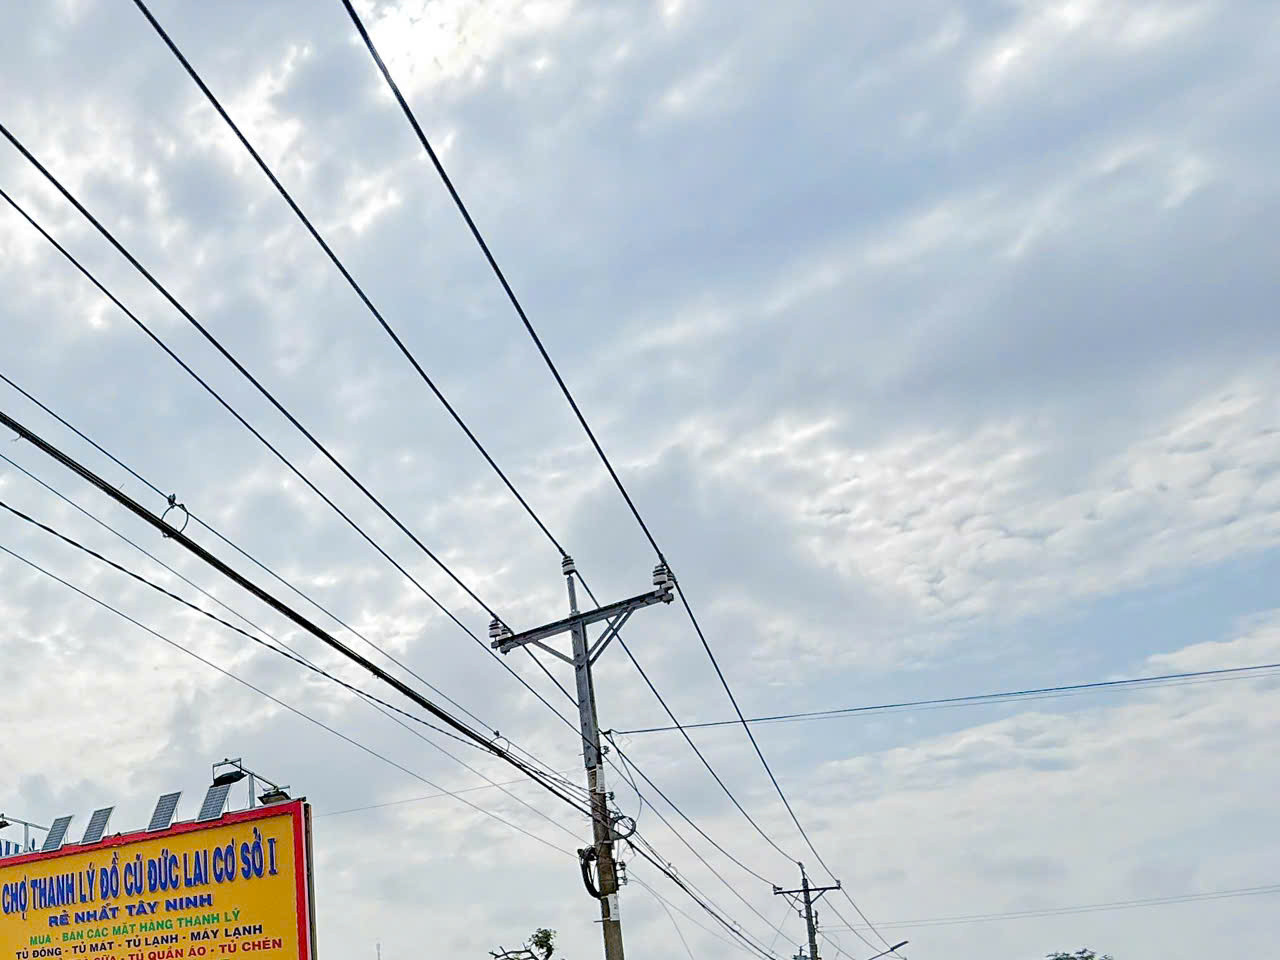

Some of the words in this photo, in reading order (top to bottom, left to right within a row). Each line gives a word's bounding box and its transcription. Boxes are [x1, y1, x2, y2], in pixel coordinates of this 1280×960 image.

[2, 874, 29, 920] CHỢ
[31, 873, 76, 910] THANH
[80, 862, 96, 903] LÝ
[100, 852, 120, 900] ĐỒ
[124, 853, 144, 896] CŨ
[147, 849, 179, 892] ĐỨC
[183, 849, 209, 887] LAI
[213, 838, 237, 883] CƠ
[241, 827, 264, 879] SỞ
[30, 936, 51, 946] MUA
[62, 930, 84, 942] BÁN
[87, 926, 109, 938] CÁC
[140, 919, 173, 932] HÀNG
[177, 913, 219, 928] THANH
[224, 908, 240, 922] LÝ
[48, 910, 70, 927] RẺ
[74, 903, 120, 923] NHẤT
[126, 900, 159, 917] TÂY
[165, 894, 213, 911] NINH
[16, 948, 29, 960] TỦ
[72, 942, 86, 954] TỦ
[90, 941, 114, 952] MÁT
[126, 937, 141, 948] TỦ
[145, 935, 178, 946] LẠNH
[191, 929, 219, 941] MÁY
[224, 925, 263, 939] LẠNH
[148, 945, 183, 960] QUẦN
[188, 945, 206, 957] ÁO
[219, 940, 237, 954] TỦ
[242, 937, 282, 951] CHÉN
